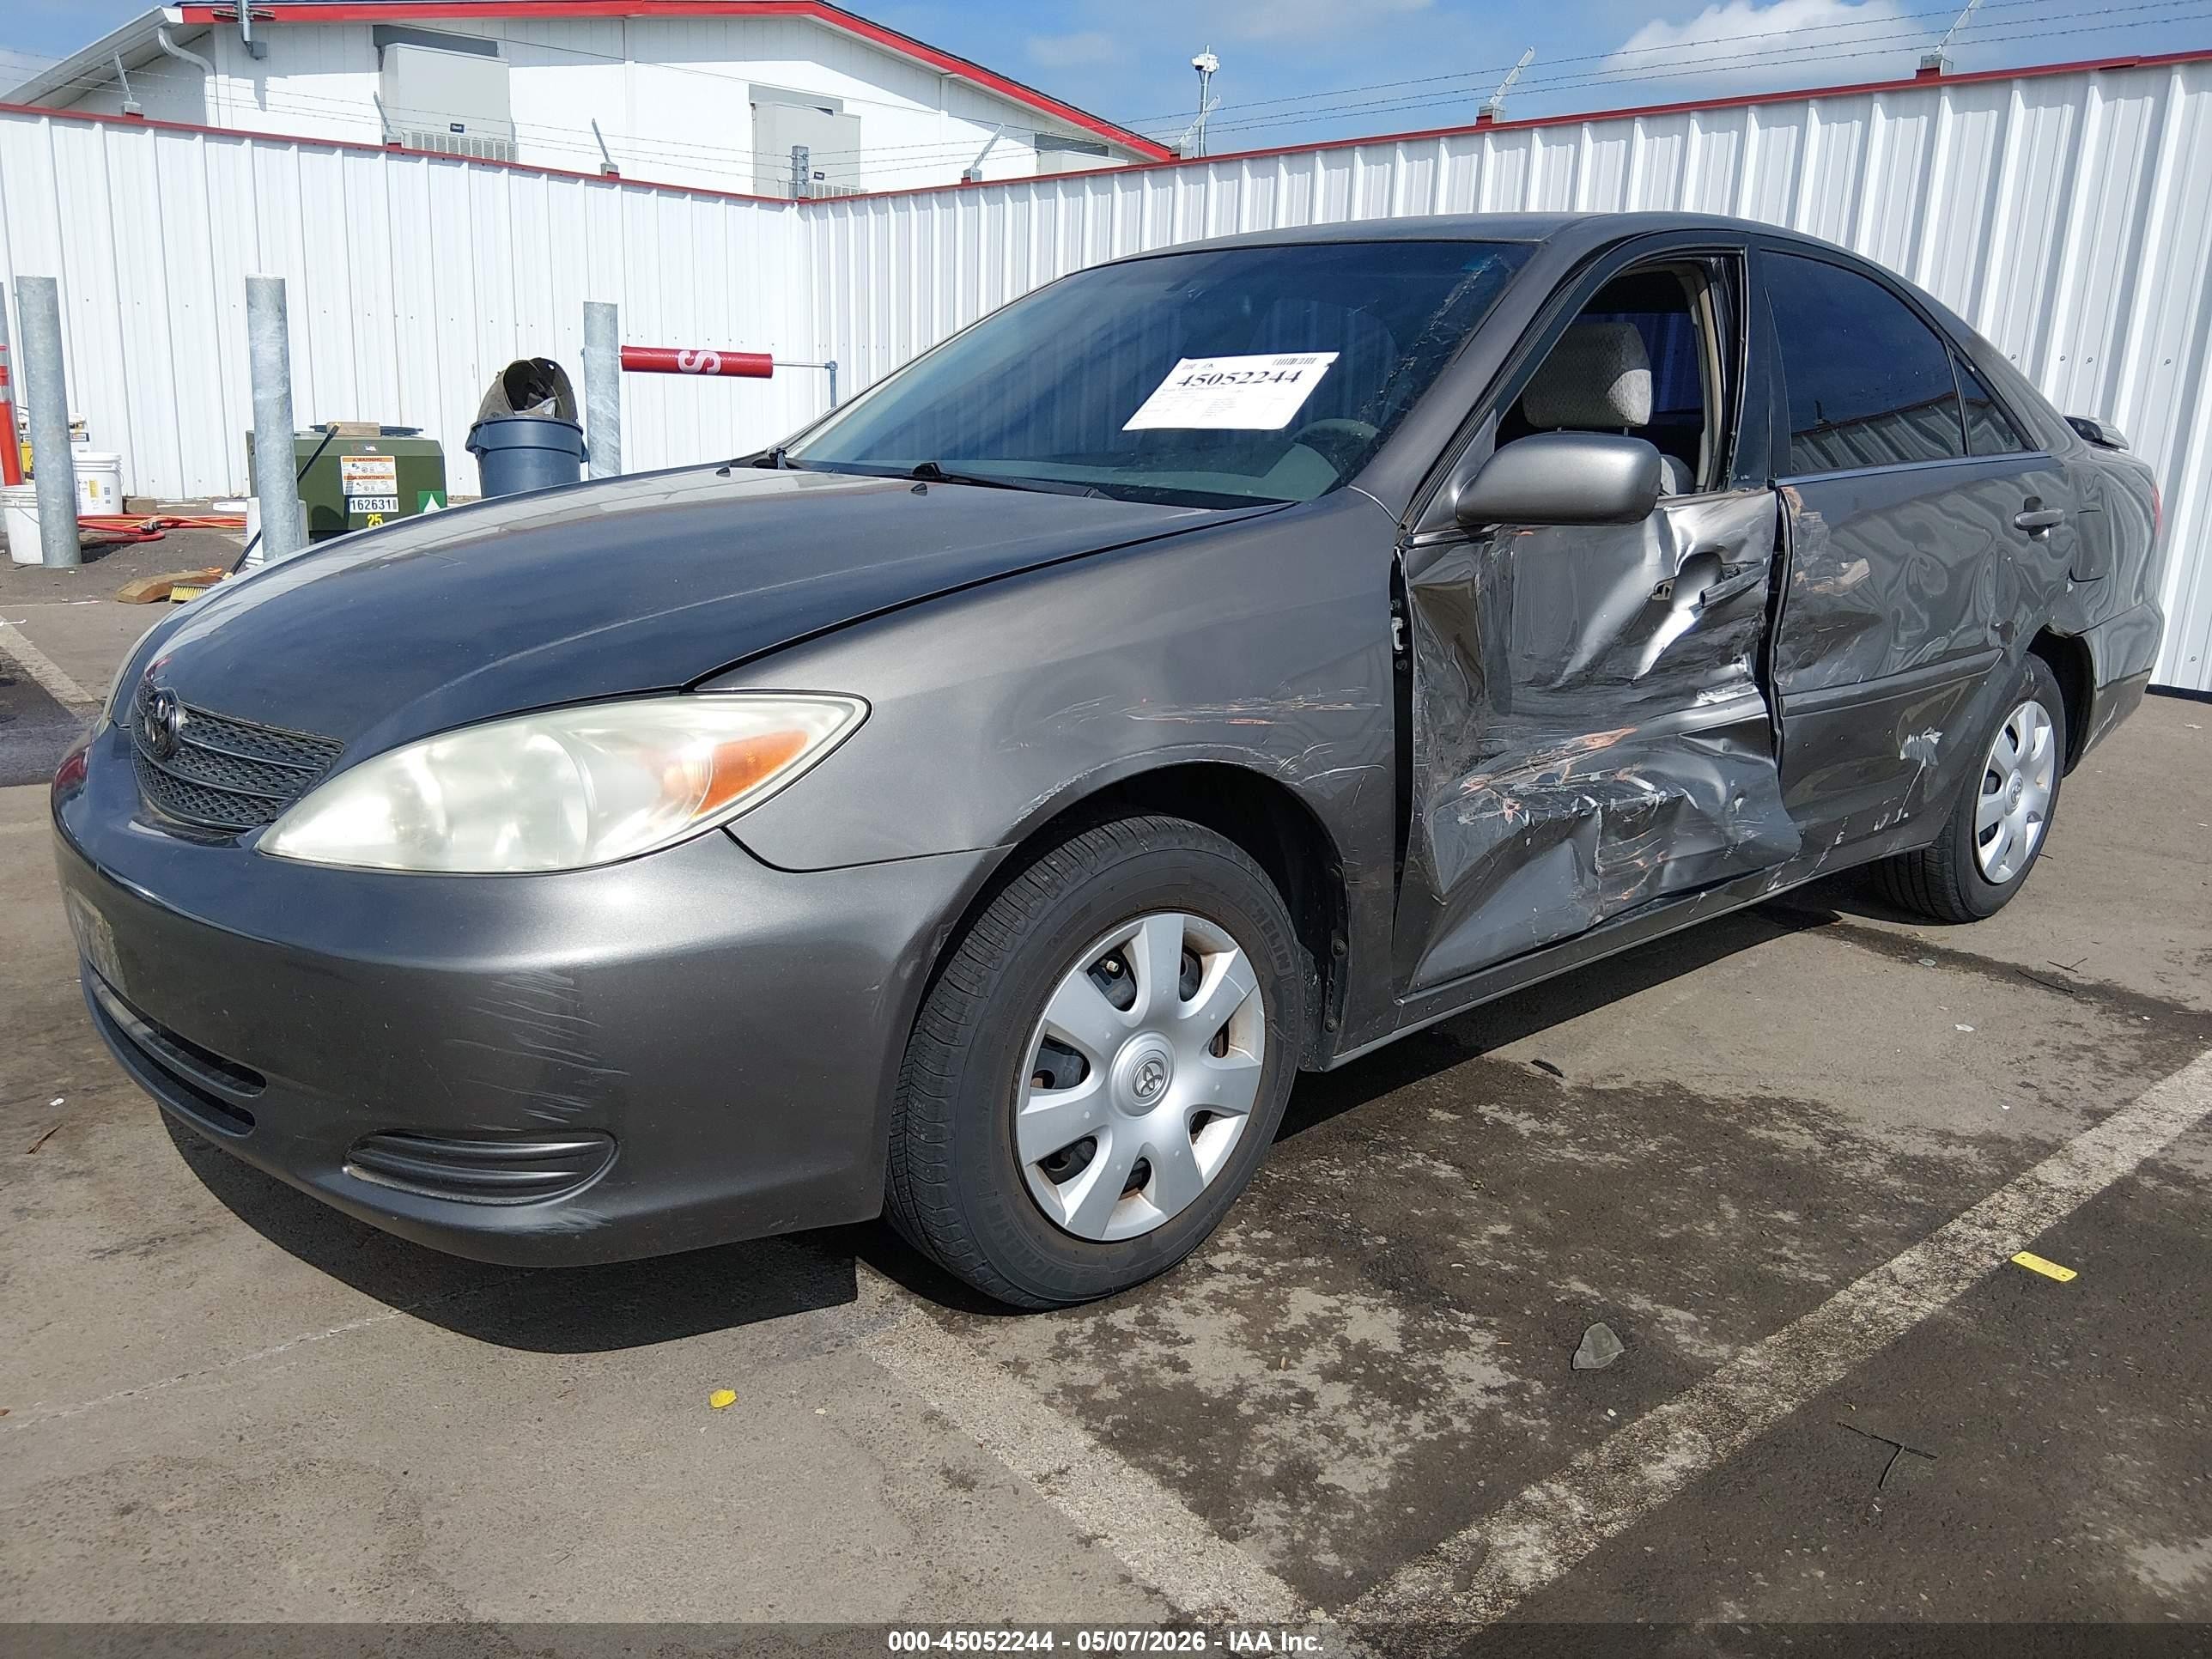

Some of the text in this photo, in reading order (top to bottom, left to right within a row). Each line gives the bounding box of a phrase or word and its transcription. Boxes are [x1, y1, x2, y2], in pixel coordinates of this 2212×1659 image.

[678, 350, 721, 374] S
[1176, 369, 1304, 387] 45052244
[350, 499, 391, 511] 162631
[368, 514, 383, 528] 25
[1234, 885, 1291, 971] ICHELIN
